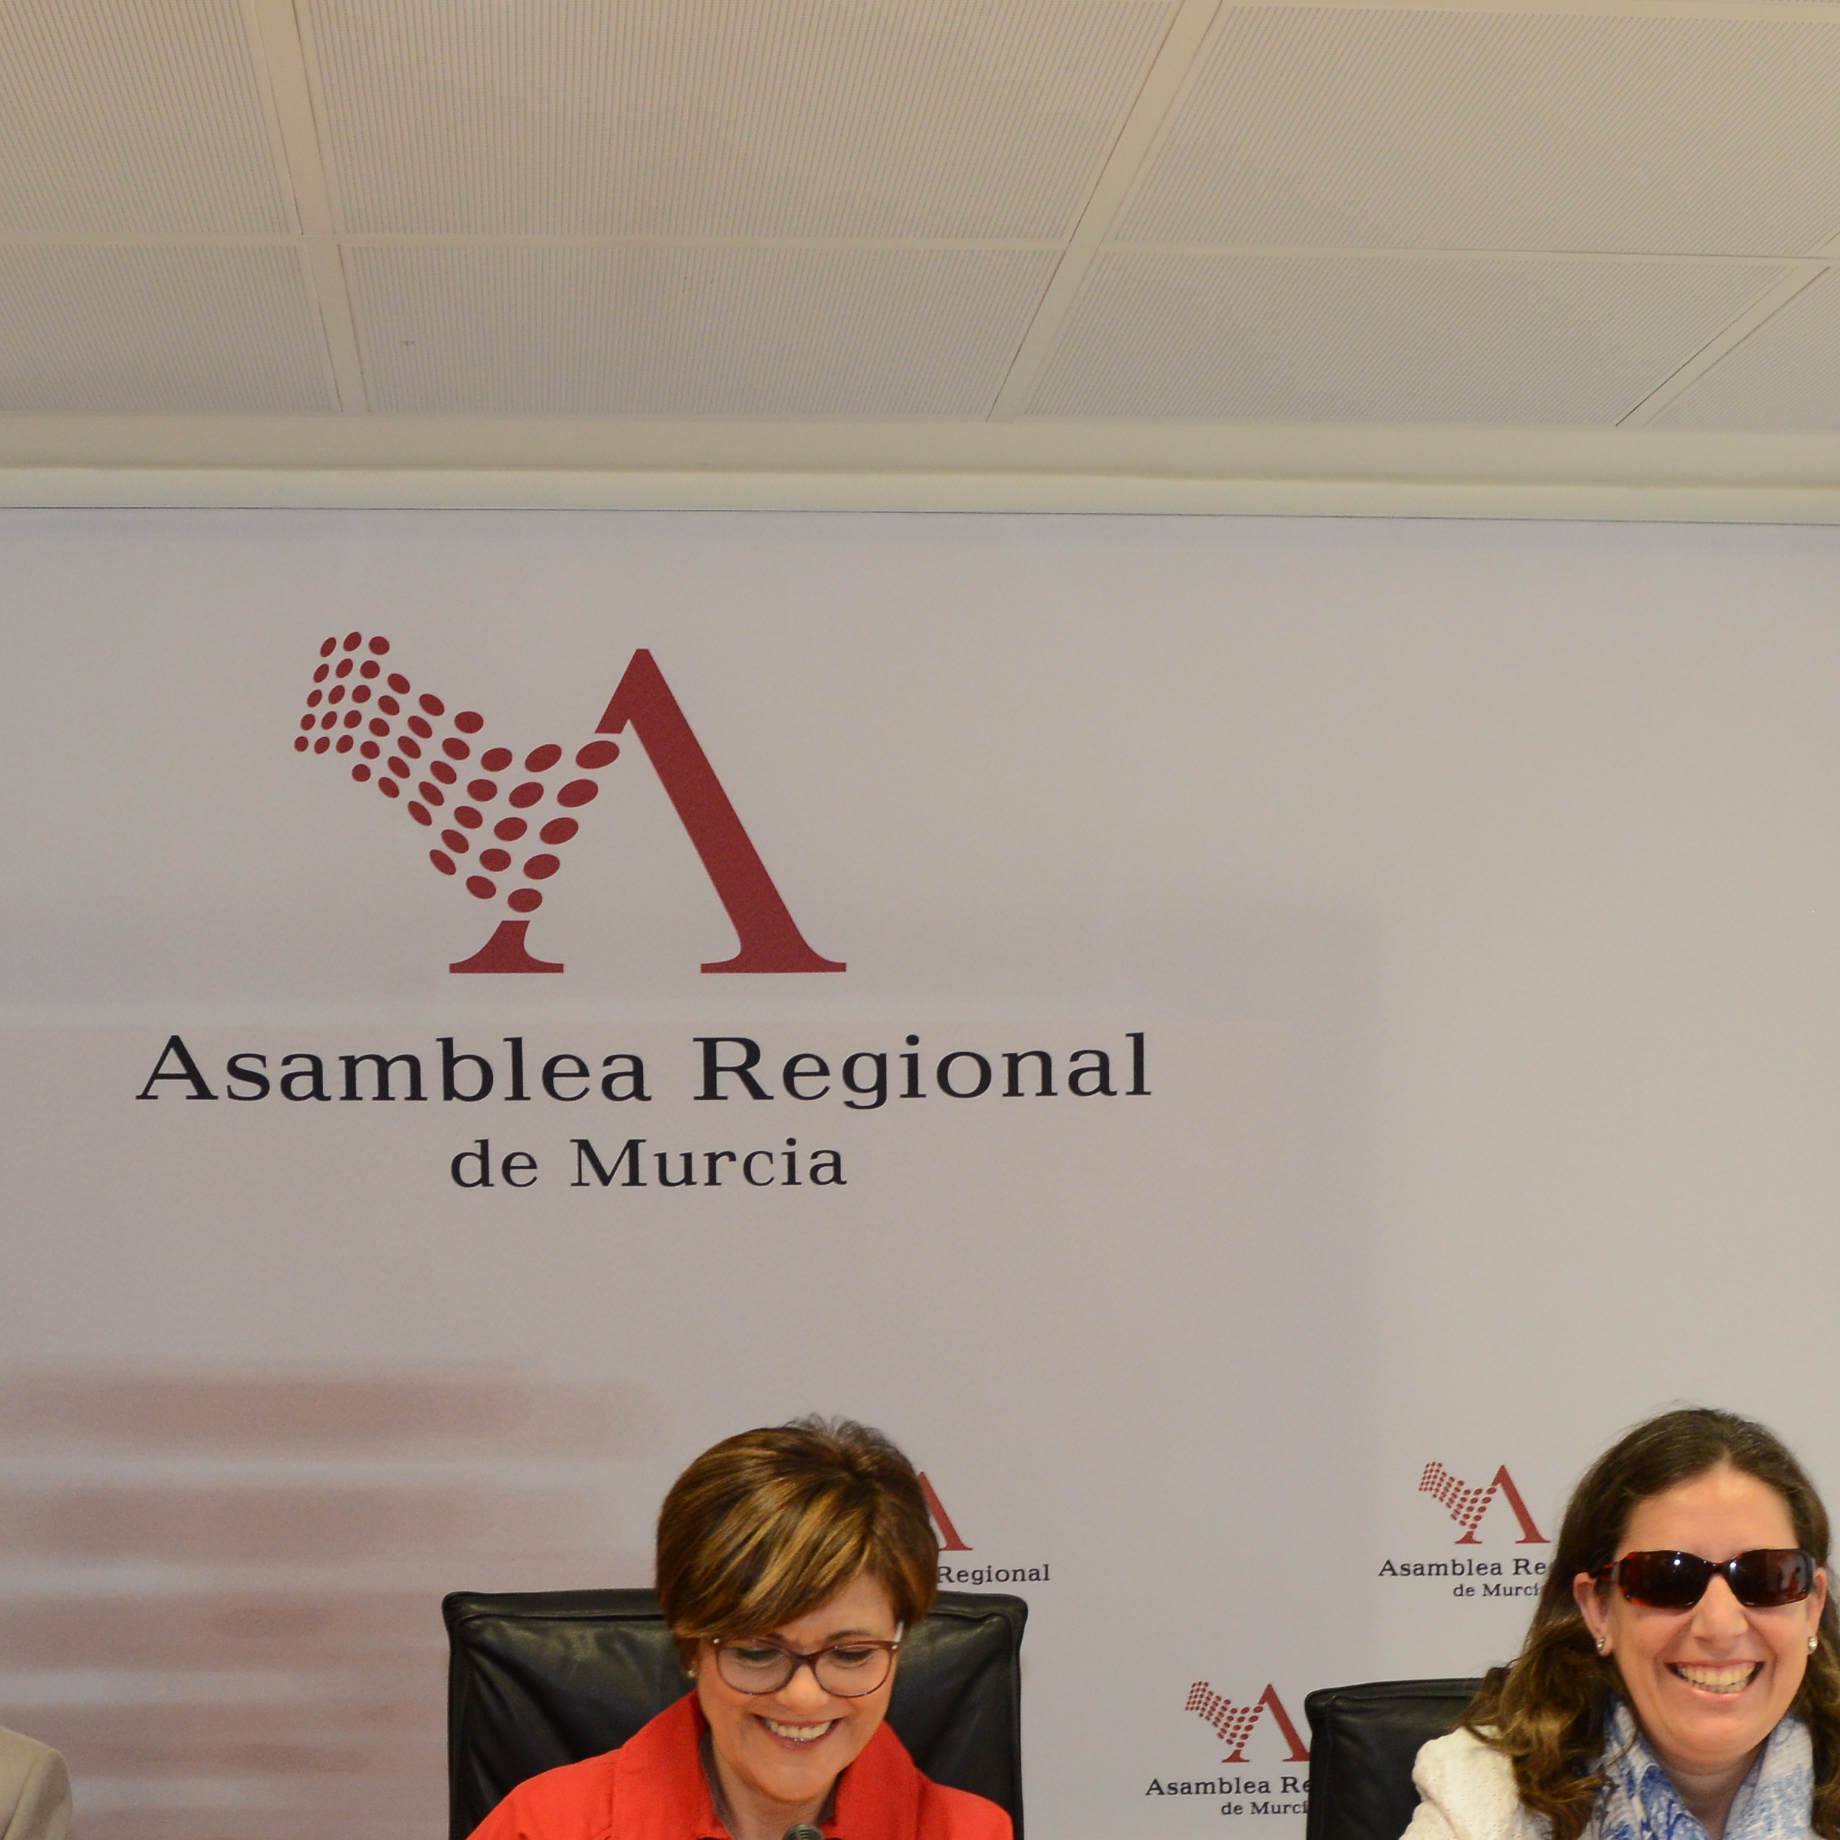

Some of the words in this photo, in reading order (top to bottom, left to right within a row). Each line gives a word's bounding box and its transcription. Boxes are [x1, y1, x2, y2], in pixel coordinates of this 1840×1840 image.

[135, 1034, 652, 1103] Asamblea
[692, 1031, 1152, 1110] Regional
[450, 1138, 539, 1189] de
[569, 1137, 848, 1189] Murcia
[937, 1563, 1051, 1586] Regional
[1378, 1558, 1503, 1577] Asamblea
[1452, 1583, 1475, 1598] de
[1482, 1582, 1540, 1598] Murci
[1145, 1776, 1272, 1796] Asamblea
[1220, 1801, 1244, 1816] de
[1250, 1800, 1309, 1816] Murci
